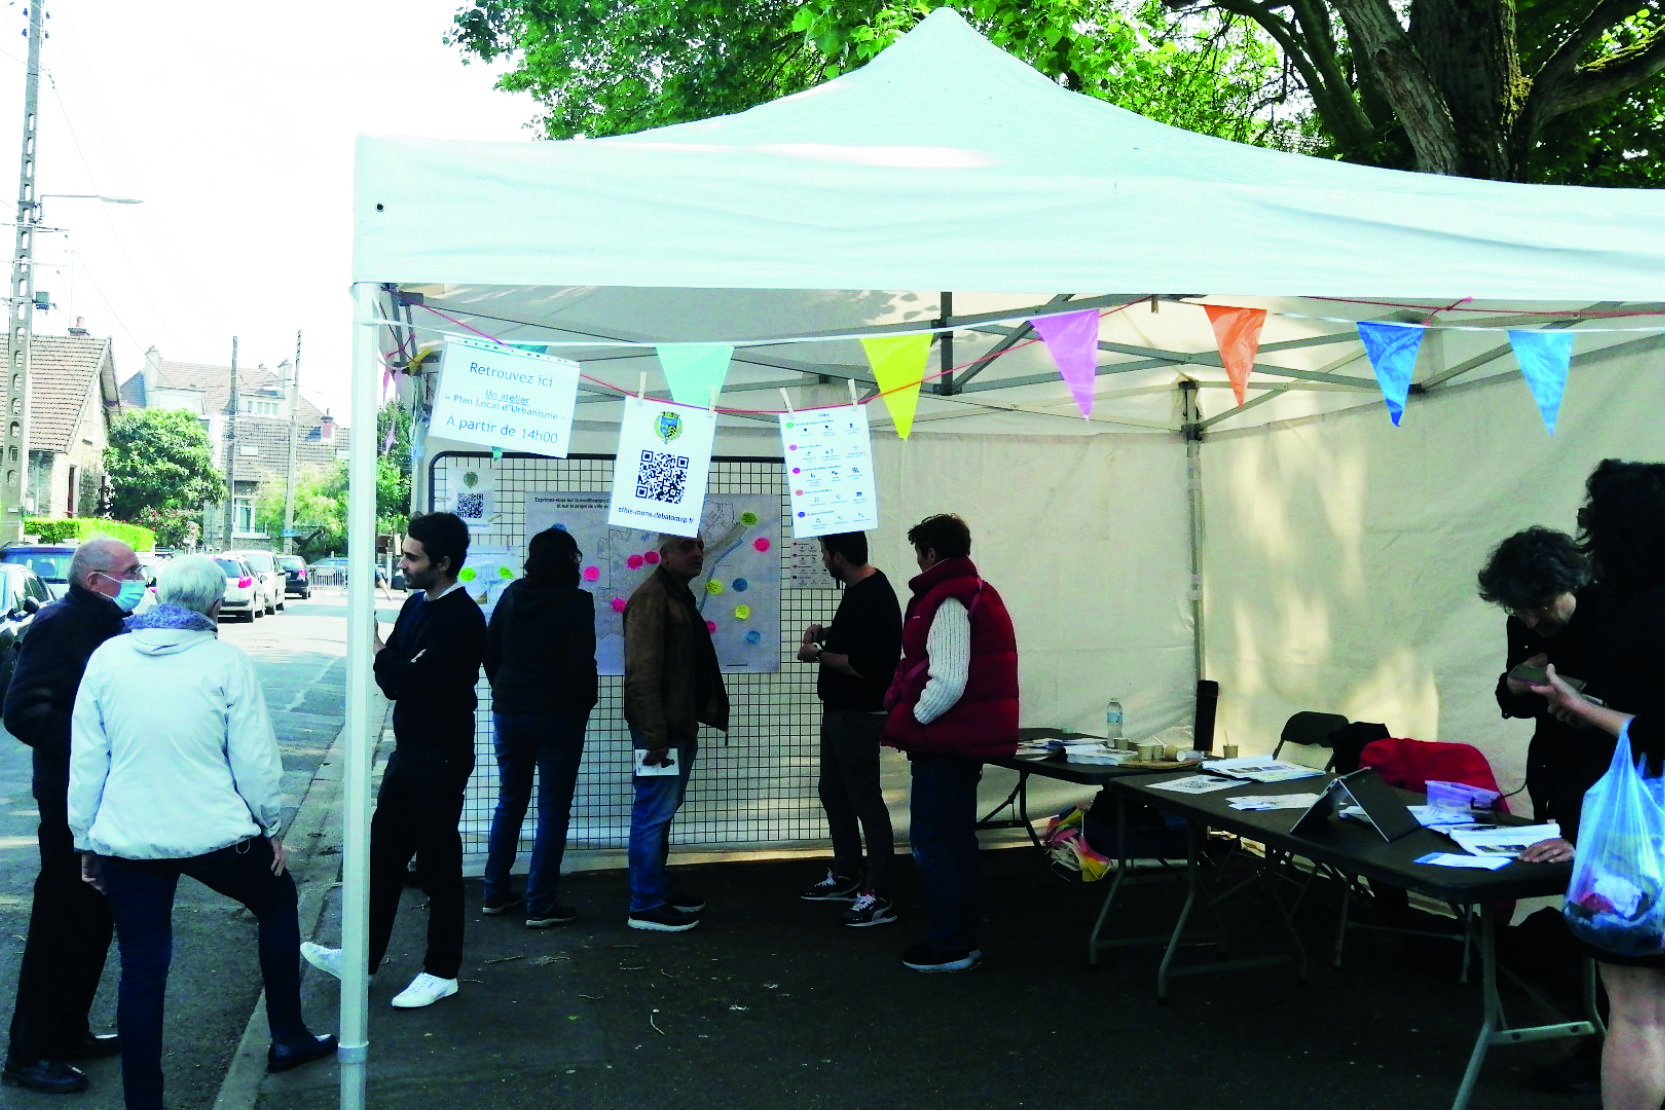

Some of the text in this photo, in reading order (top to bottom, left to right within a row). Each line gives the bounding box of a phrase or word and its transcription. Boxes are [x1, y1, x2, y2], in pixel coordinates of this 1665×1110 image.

[470, 362, 553, 388] Retrouvez ici
[453, 394, 473, 405] Plan
[475, 398, 501, 411] Local
[485, 389, 530, 404] Un atelier
[458, 418, 497, 433] partir
[500, 423, 516, 437] de
[521, 428, 558, 444] 14h00
